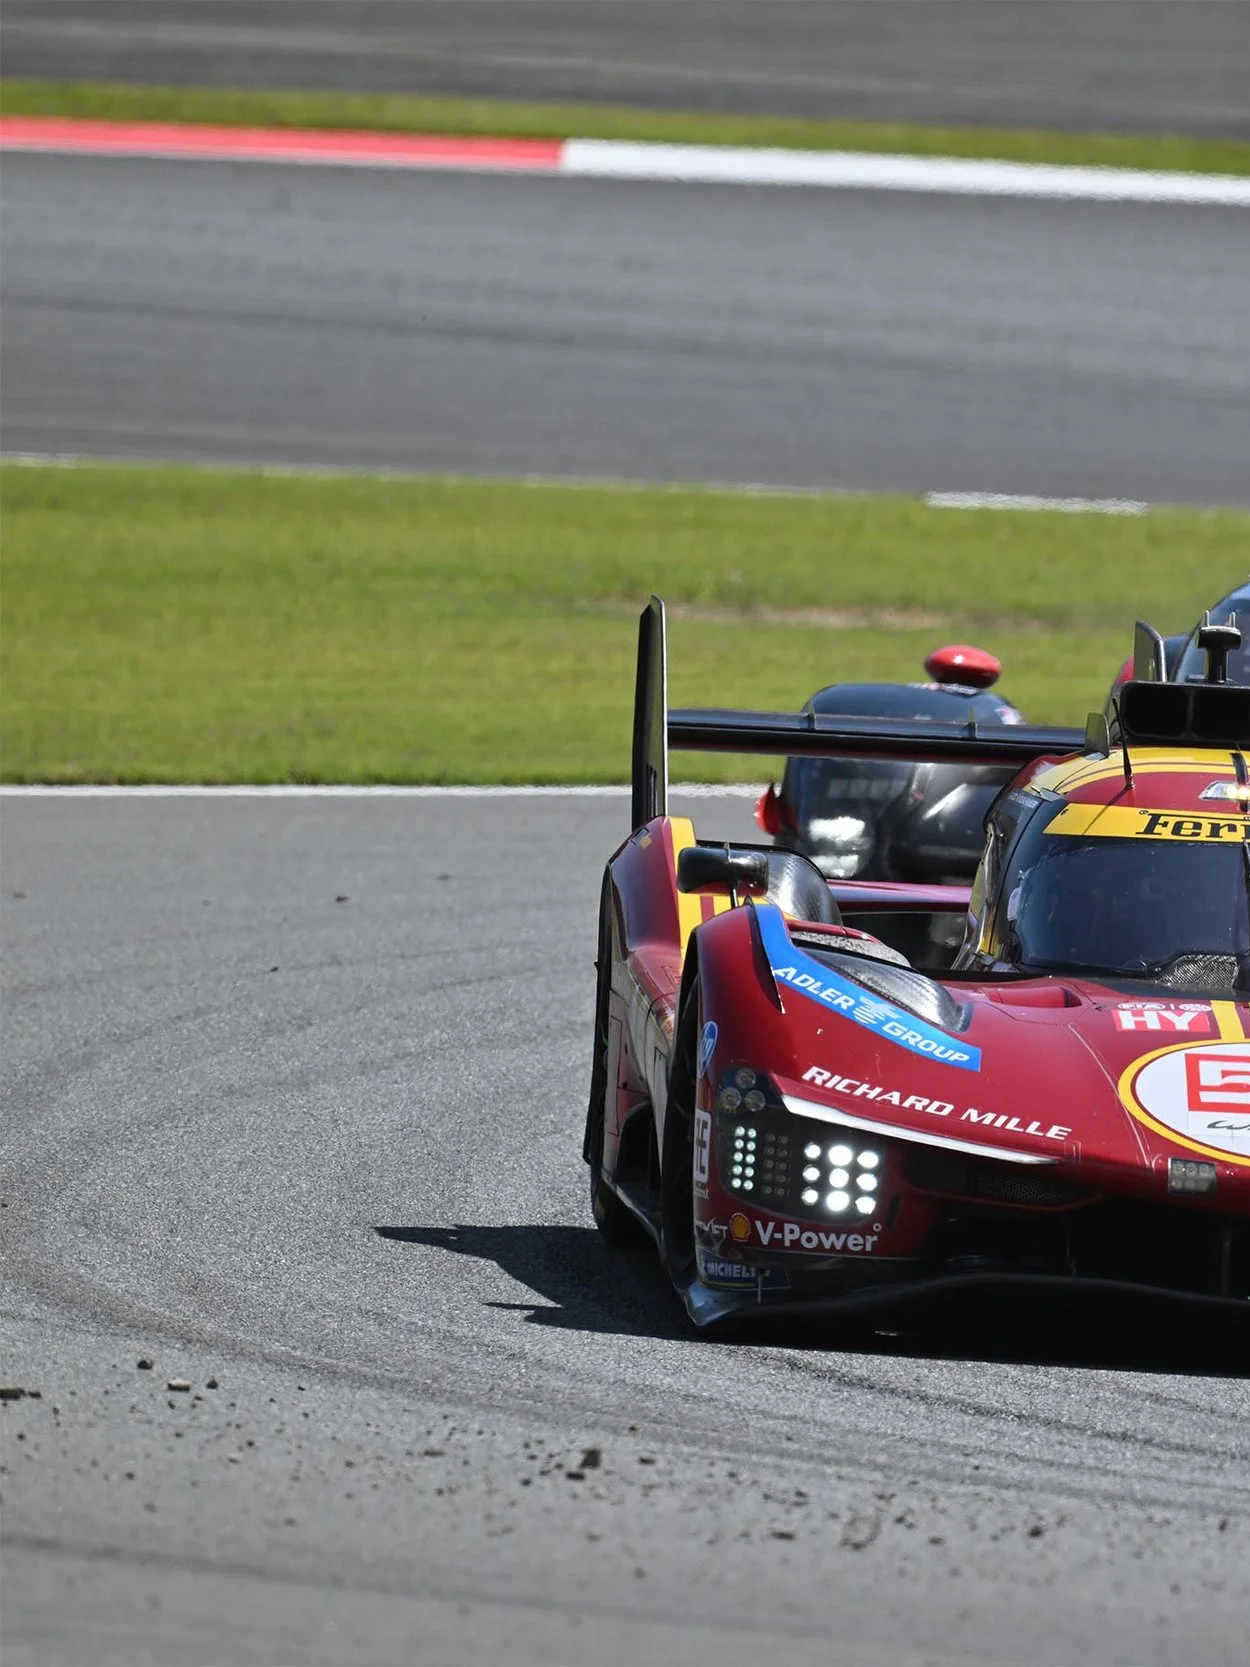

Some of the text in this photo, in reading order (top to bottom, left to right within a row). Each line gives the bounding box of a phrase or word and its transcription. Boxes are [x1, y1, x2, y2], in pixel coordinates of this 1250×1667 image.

[772, 966, 970, 1064] ADLER GROUP
[1118, 1010, 1199, 1031] HY
[801, 1065, 1072, 1140] RICHARD MILLE
[754, 1220, 878, 1252] V-Power
